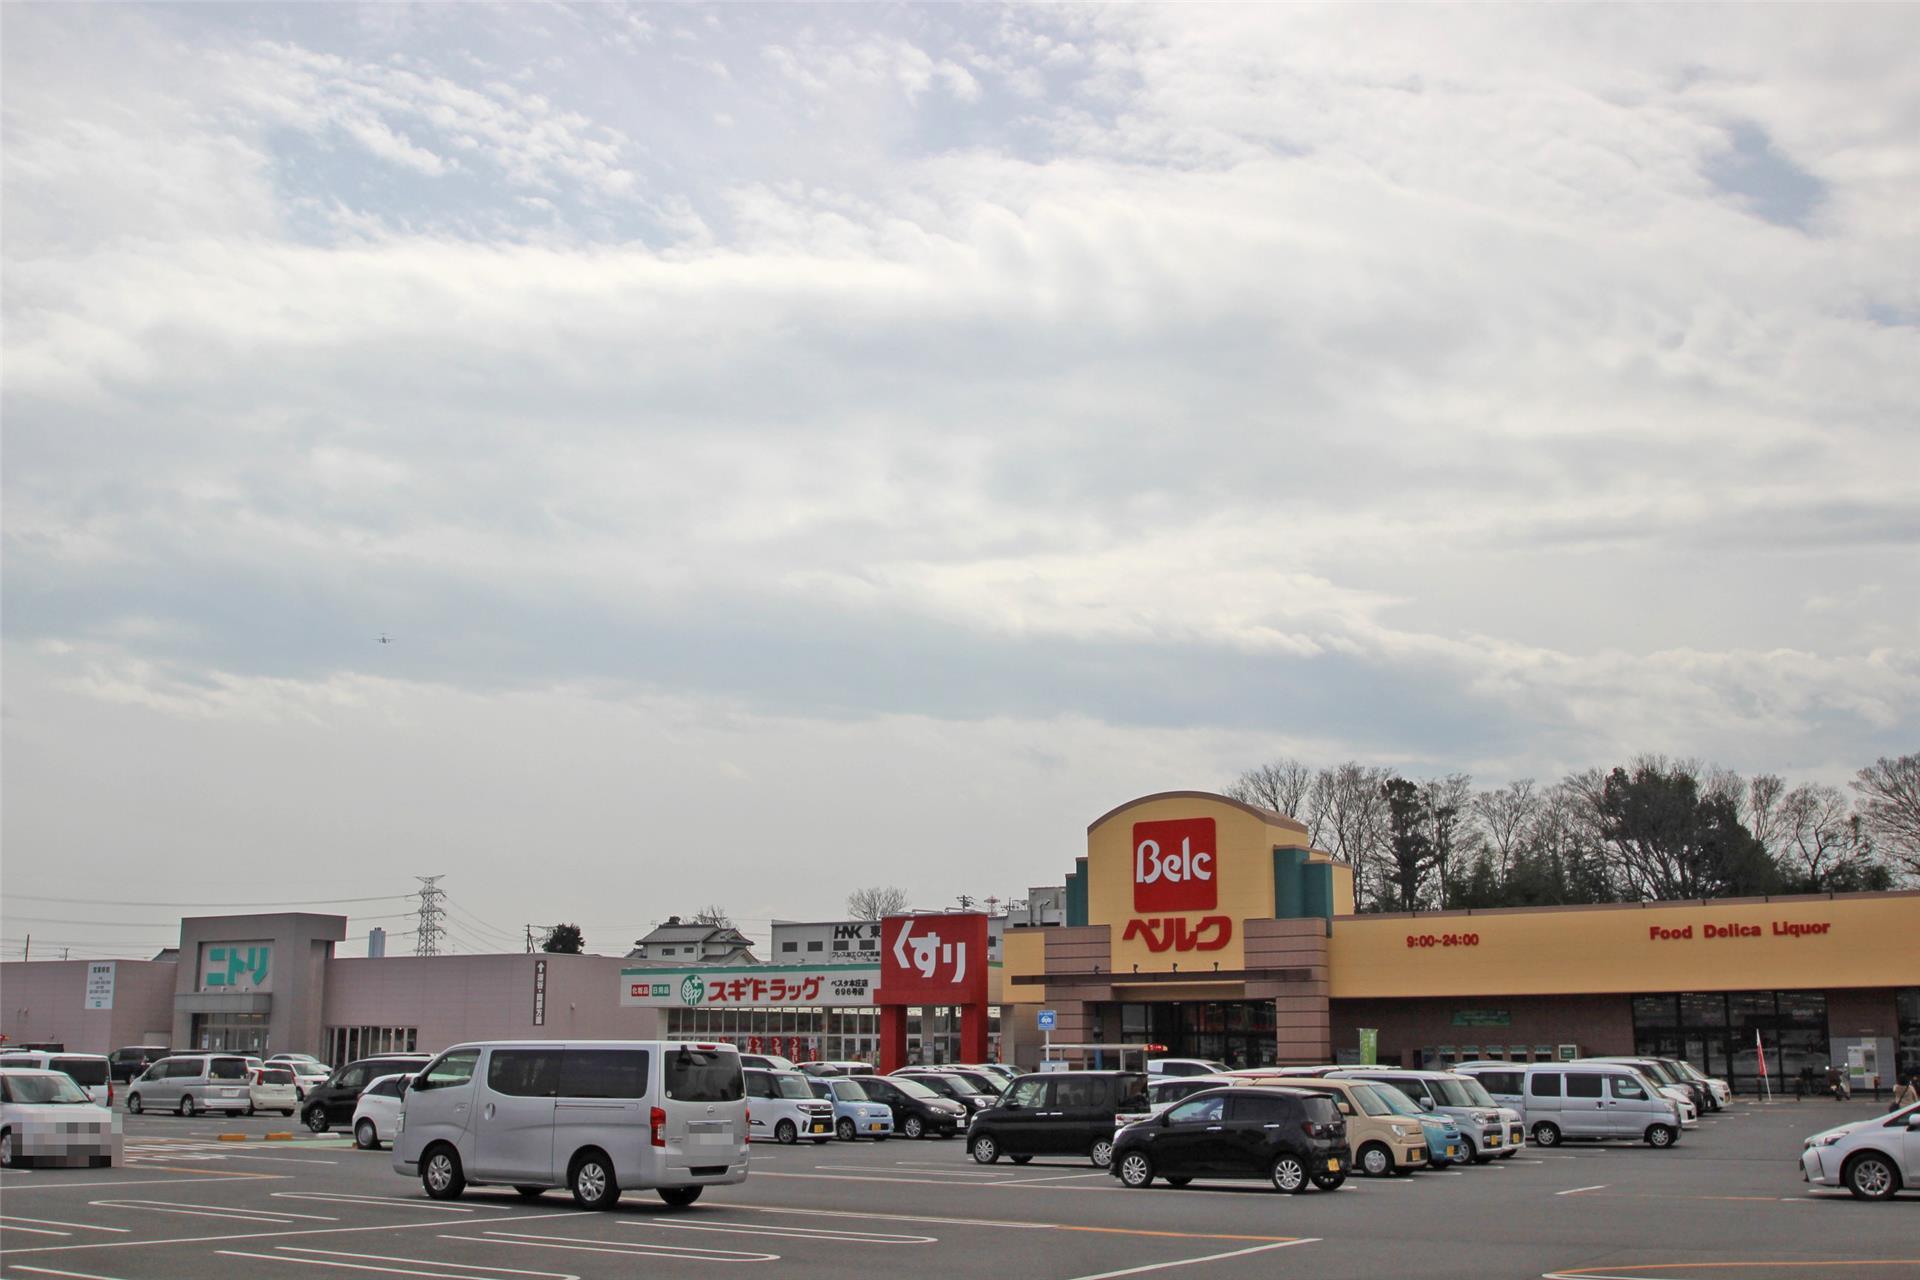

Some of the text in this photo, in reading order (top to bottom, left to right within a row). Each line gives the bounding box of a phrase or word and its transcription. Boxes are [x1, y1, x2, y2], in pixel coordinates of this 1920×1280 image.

[1136, 836, 1211, 884] Belc
[834, 925, 863, 939] HNK
[1122, 916, 1232, 953] ベルク
[1649, 921, 1830, 940] Food Delica Liquor
[207, 946, 269, 986] ニトリ
[893, 920, 966, 983] くすり
[707, 976, 825, 1002] スギドラッグ
